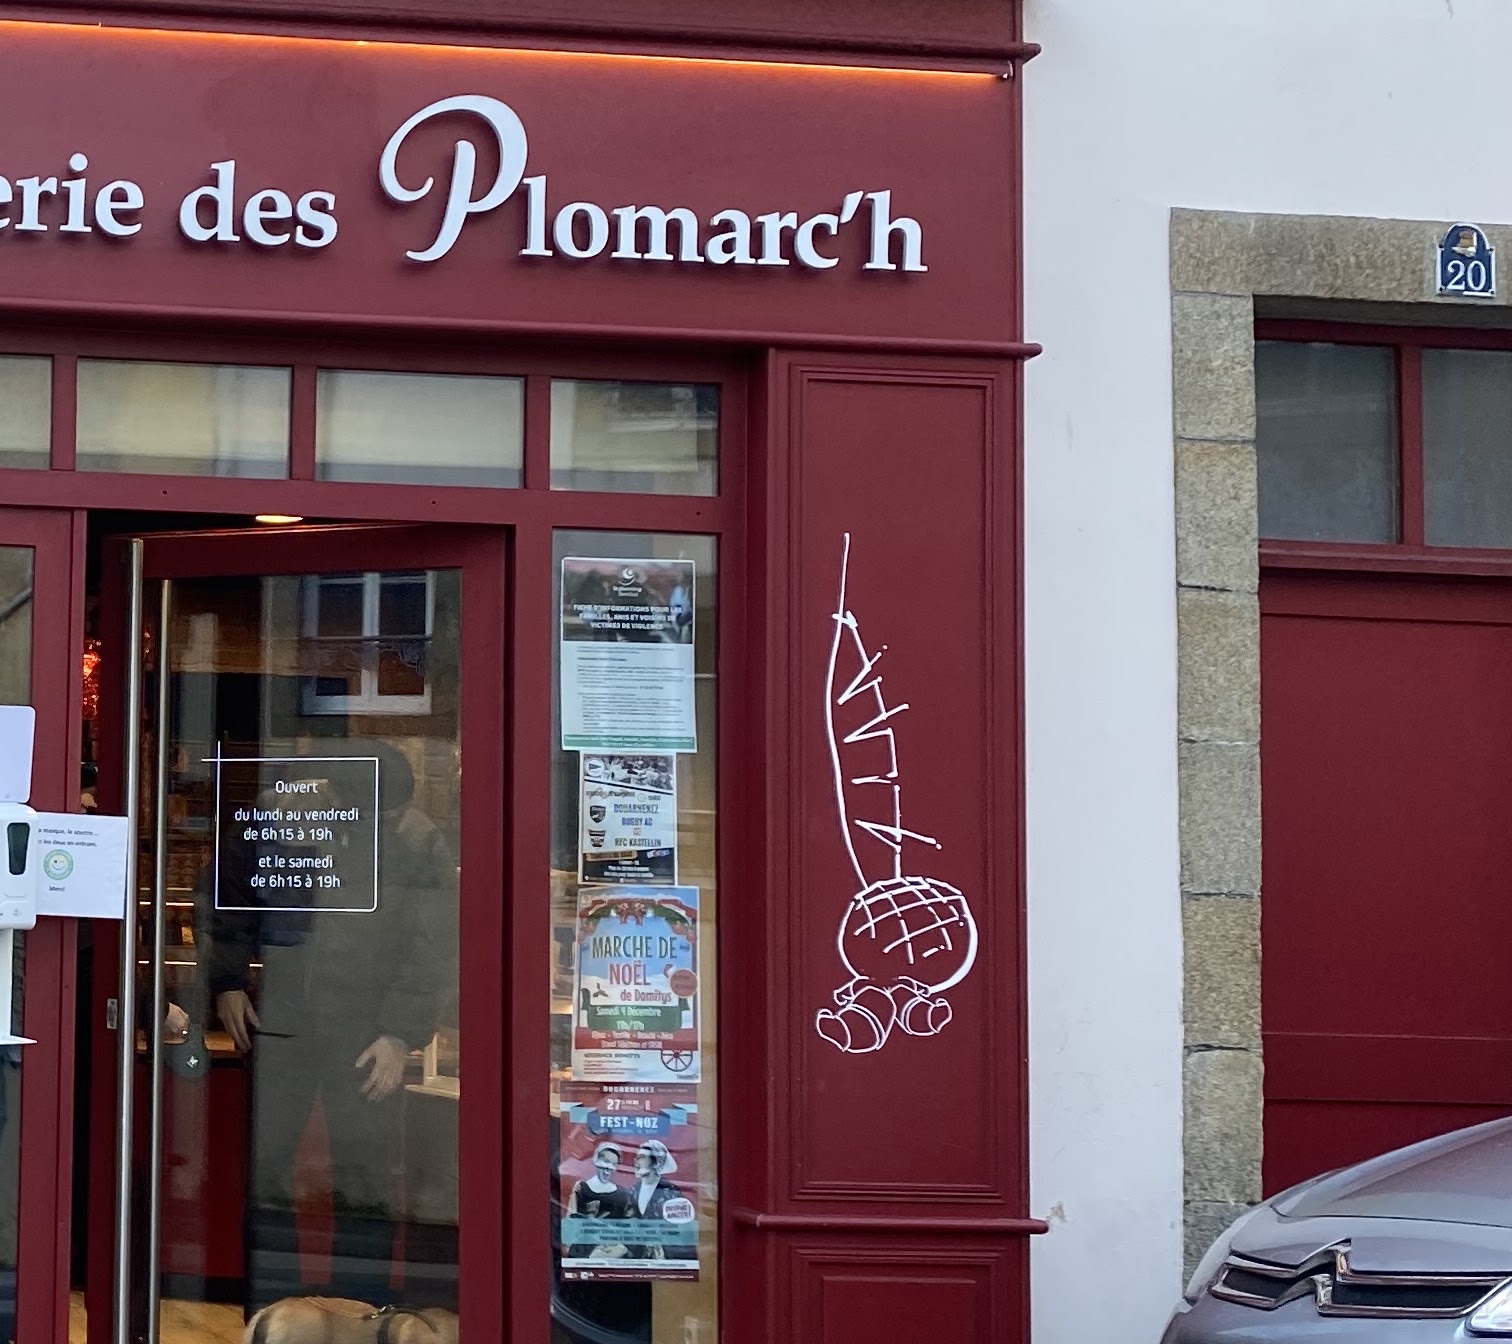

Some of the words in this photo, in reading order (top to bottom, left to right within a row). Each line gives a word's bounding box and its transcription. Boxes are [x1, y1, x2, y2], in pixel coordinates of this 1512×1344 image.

[178, 160, 340, 248] des
[379, 93, 928, 273] Plomarc'h
[1446, 260, 1487, 291] 20
[275, 780, 319, 794] Ouvert
[234, 808, 250, 821] du
[253, 808, 283, 821] lundi
[286, 811, 301, 821] au
[304, 807, 359, 821] vendredi
[243, 827, 259, 841] de
[261, 827, 294, 841] 6h15
[297, 826, 305, 841] à
[309, 827, 333, 841] 19h
[258, 856, 272, 868] et
[274, 855, 286, 868] le
[288, 855, 333, 869] samedi
[250, 874, 266, 888] de
[268, 874, 302, 888] 6h15
[304, 873, 313, 888] à
[317, 874, 341, 888] 19h
[592, 936, 653, 958] MARCHE
[658, 936, 678, 958] DE
[609, 959, 652, 986] NOËL
[620, 989, 632, 1001] de
[634, 989, 672, 1004] Domitys
[606, 1098, 621, 1111] 27
[599, 1115, 658, 1129] FEST-NOZ
